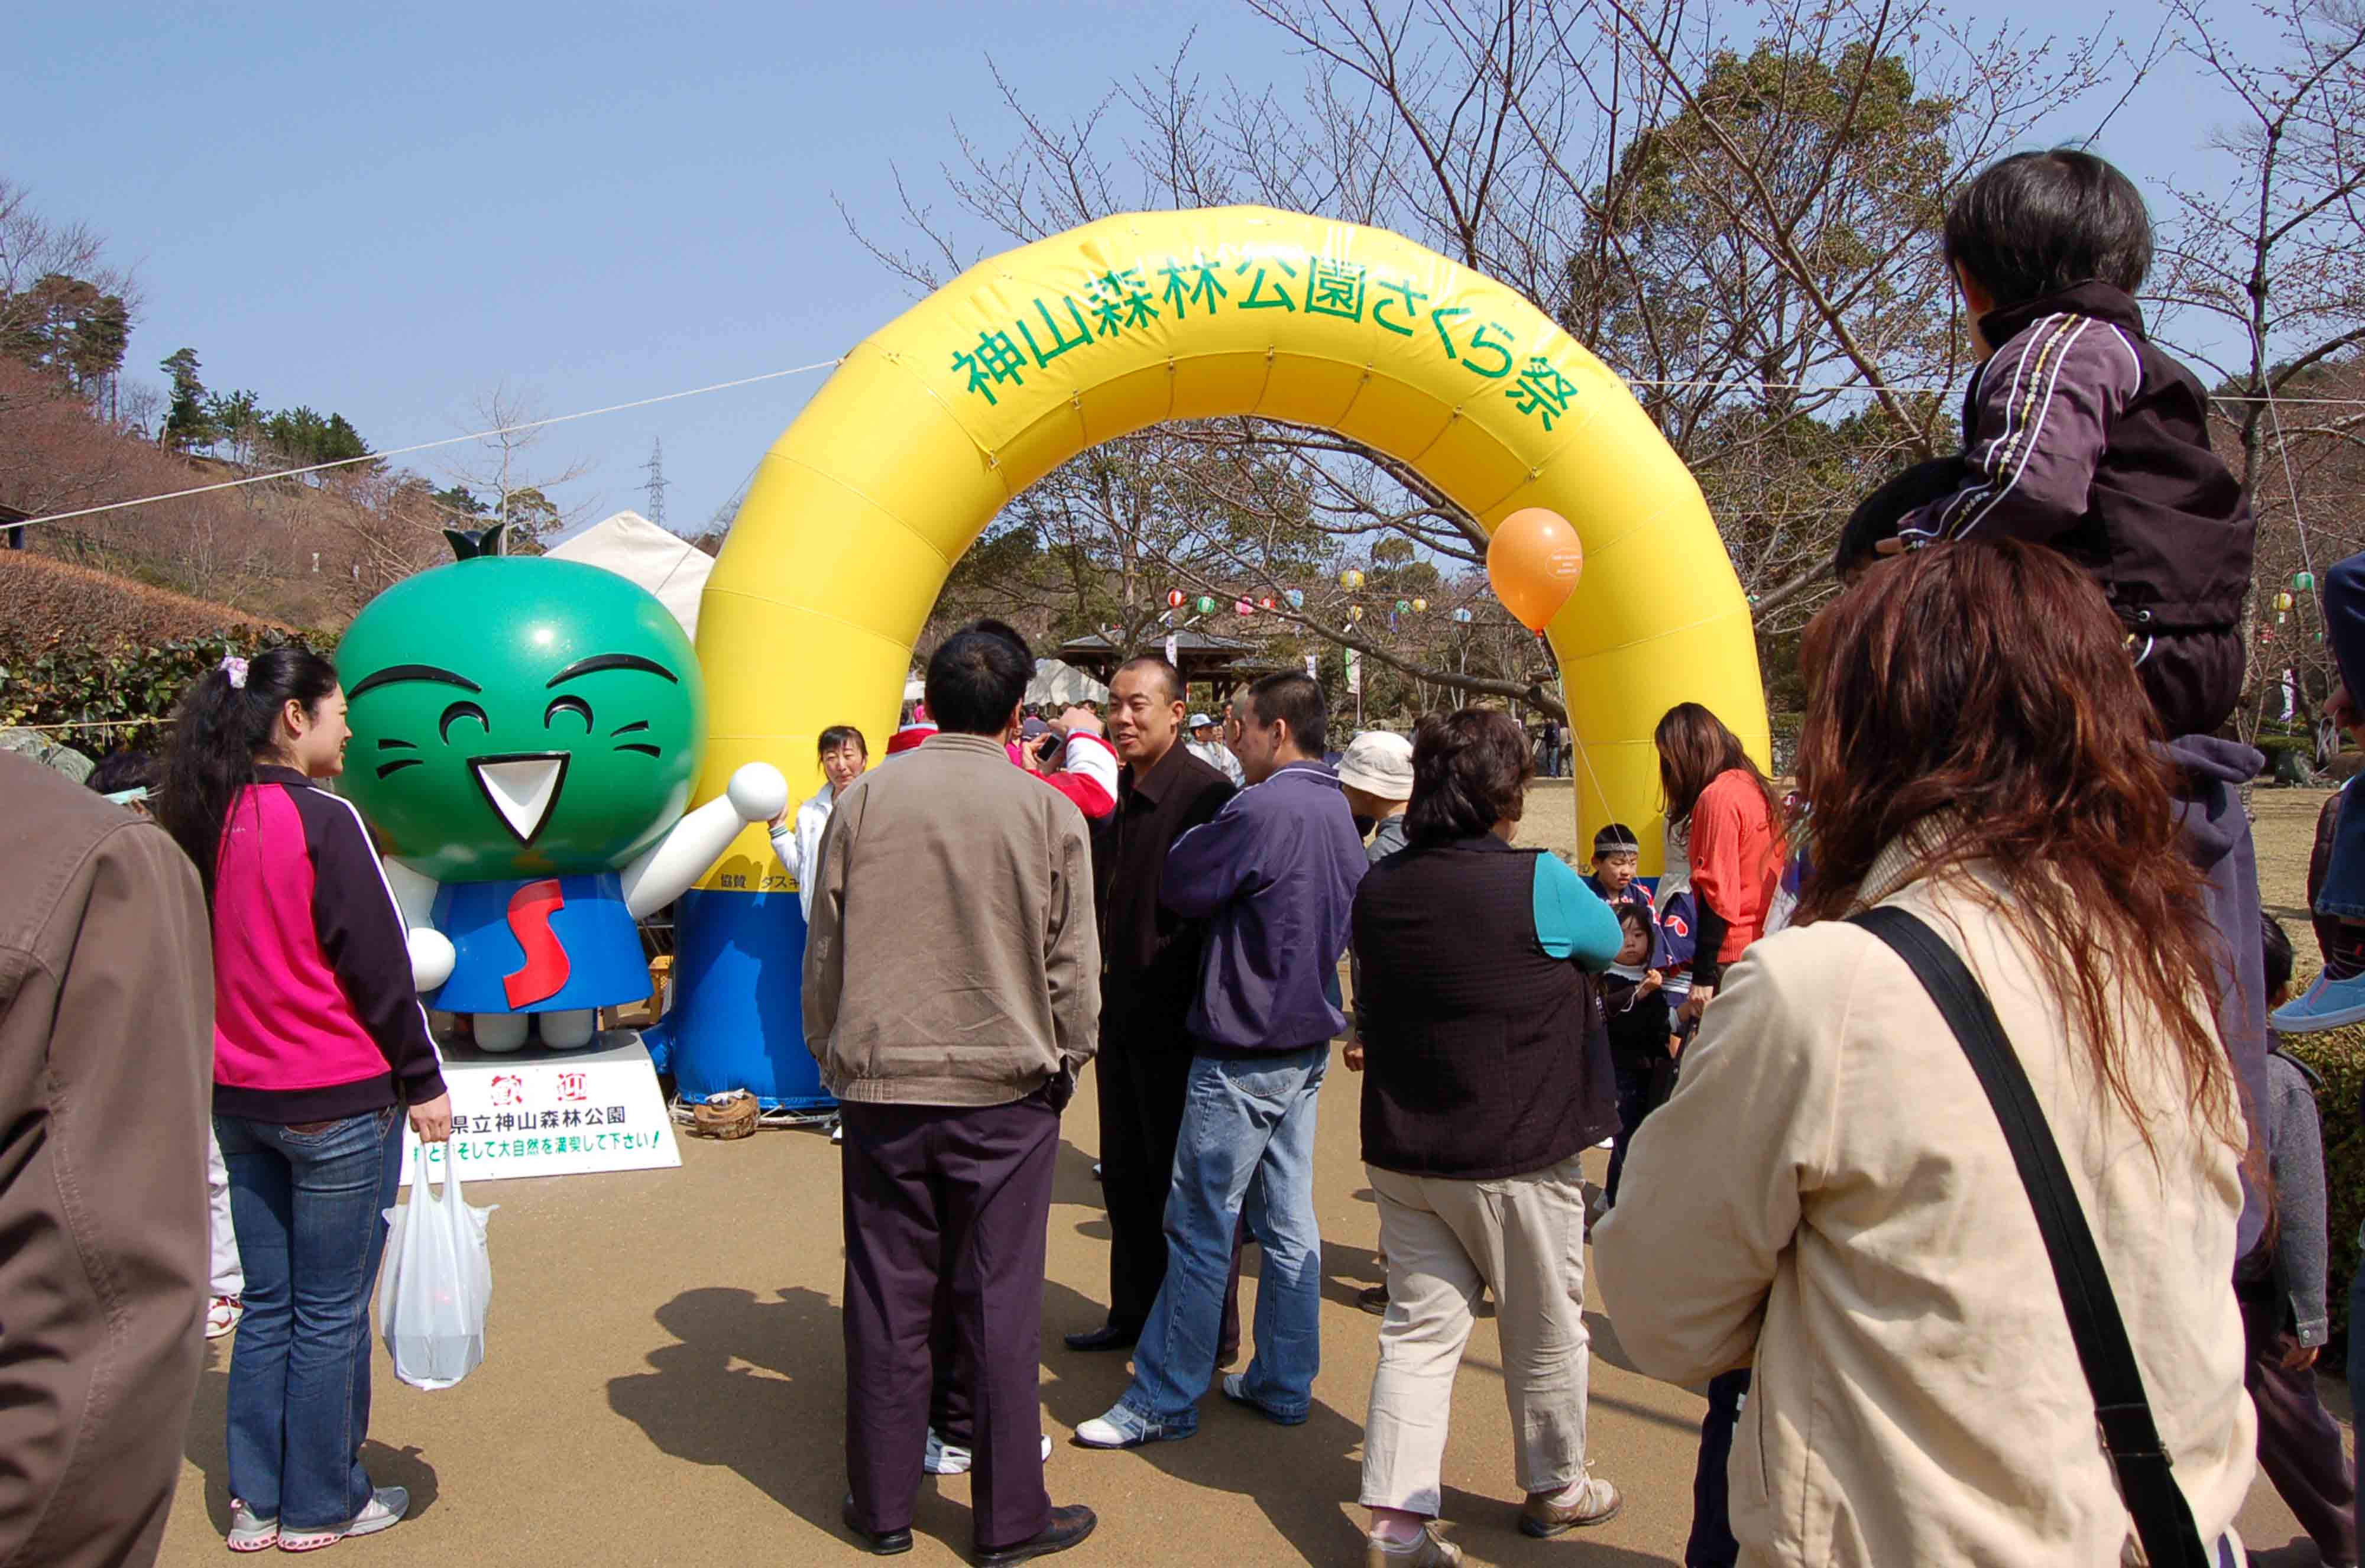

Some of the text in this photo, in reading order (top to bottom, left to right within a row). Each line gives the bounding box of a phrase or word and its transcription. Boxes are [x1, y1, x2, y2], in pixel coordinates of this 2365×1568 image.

[950, 251, 1579, 431] 神山森林公園さくら祭
[451, 1106, 625, 1135] 県立神山森林公園
[414, 1130, 660, 1162] とそして大自然を満喫して下さい!
